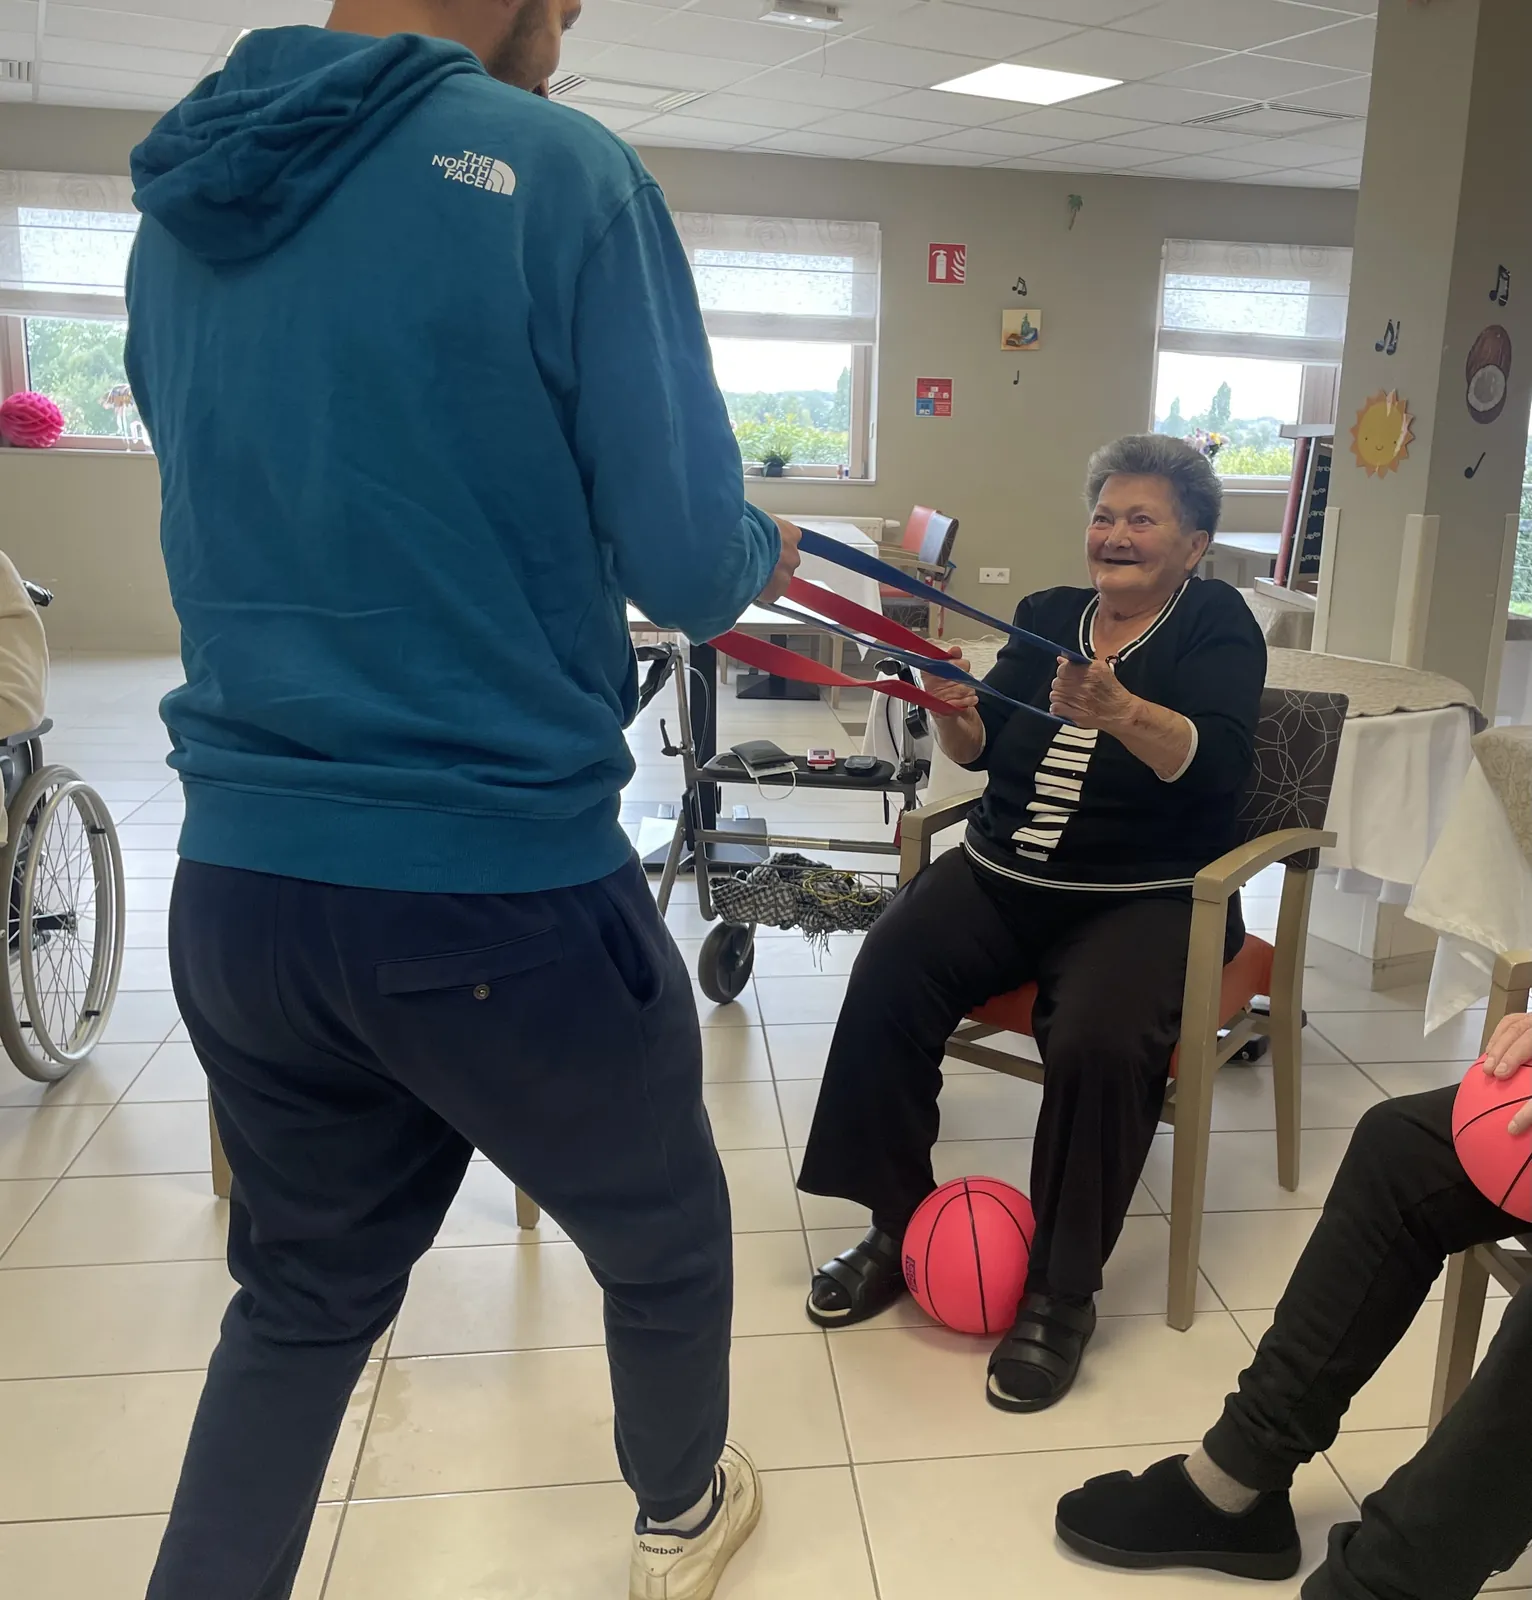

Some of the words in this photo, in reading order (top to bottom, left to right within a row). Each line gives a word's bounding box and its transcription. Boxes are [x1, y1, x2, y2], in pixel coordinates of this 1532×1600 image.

[431, 154, 490, 178] NORTH
[463, 150, 493, 168] THE
[443, 168, 484, 188] FACE
[639, 1540, 684, 1555] Reebok
